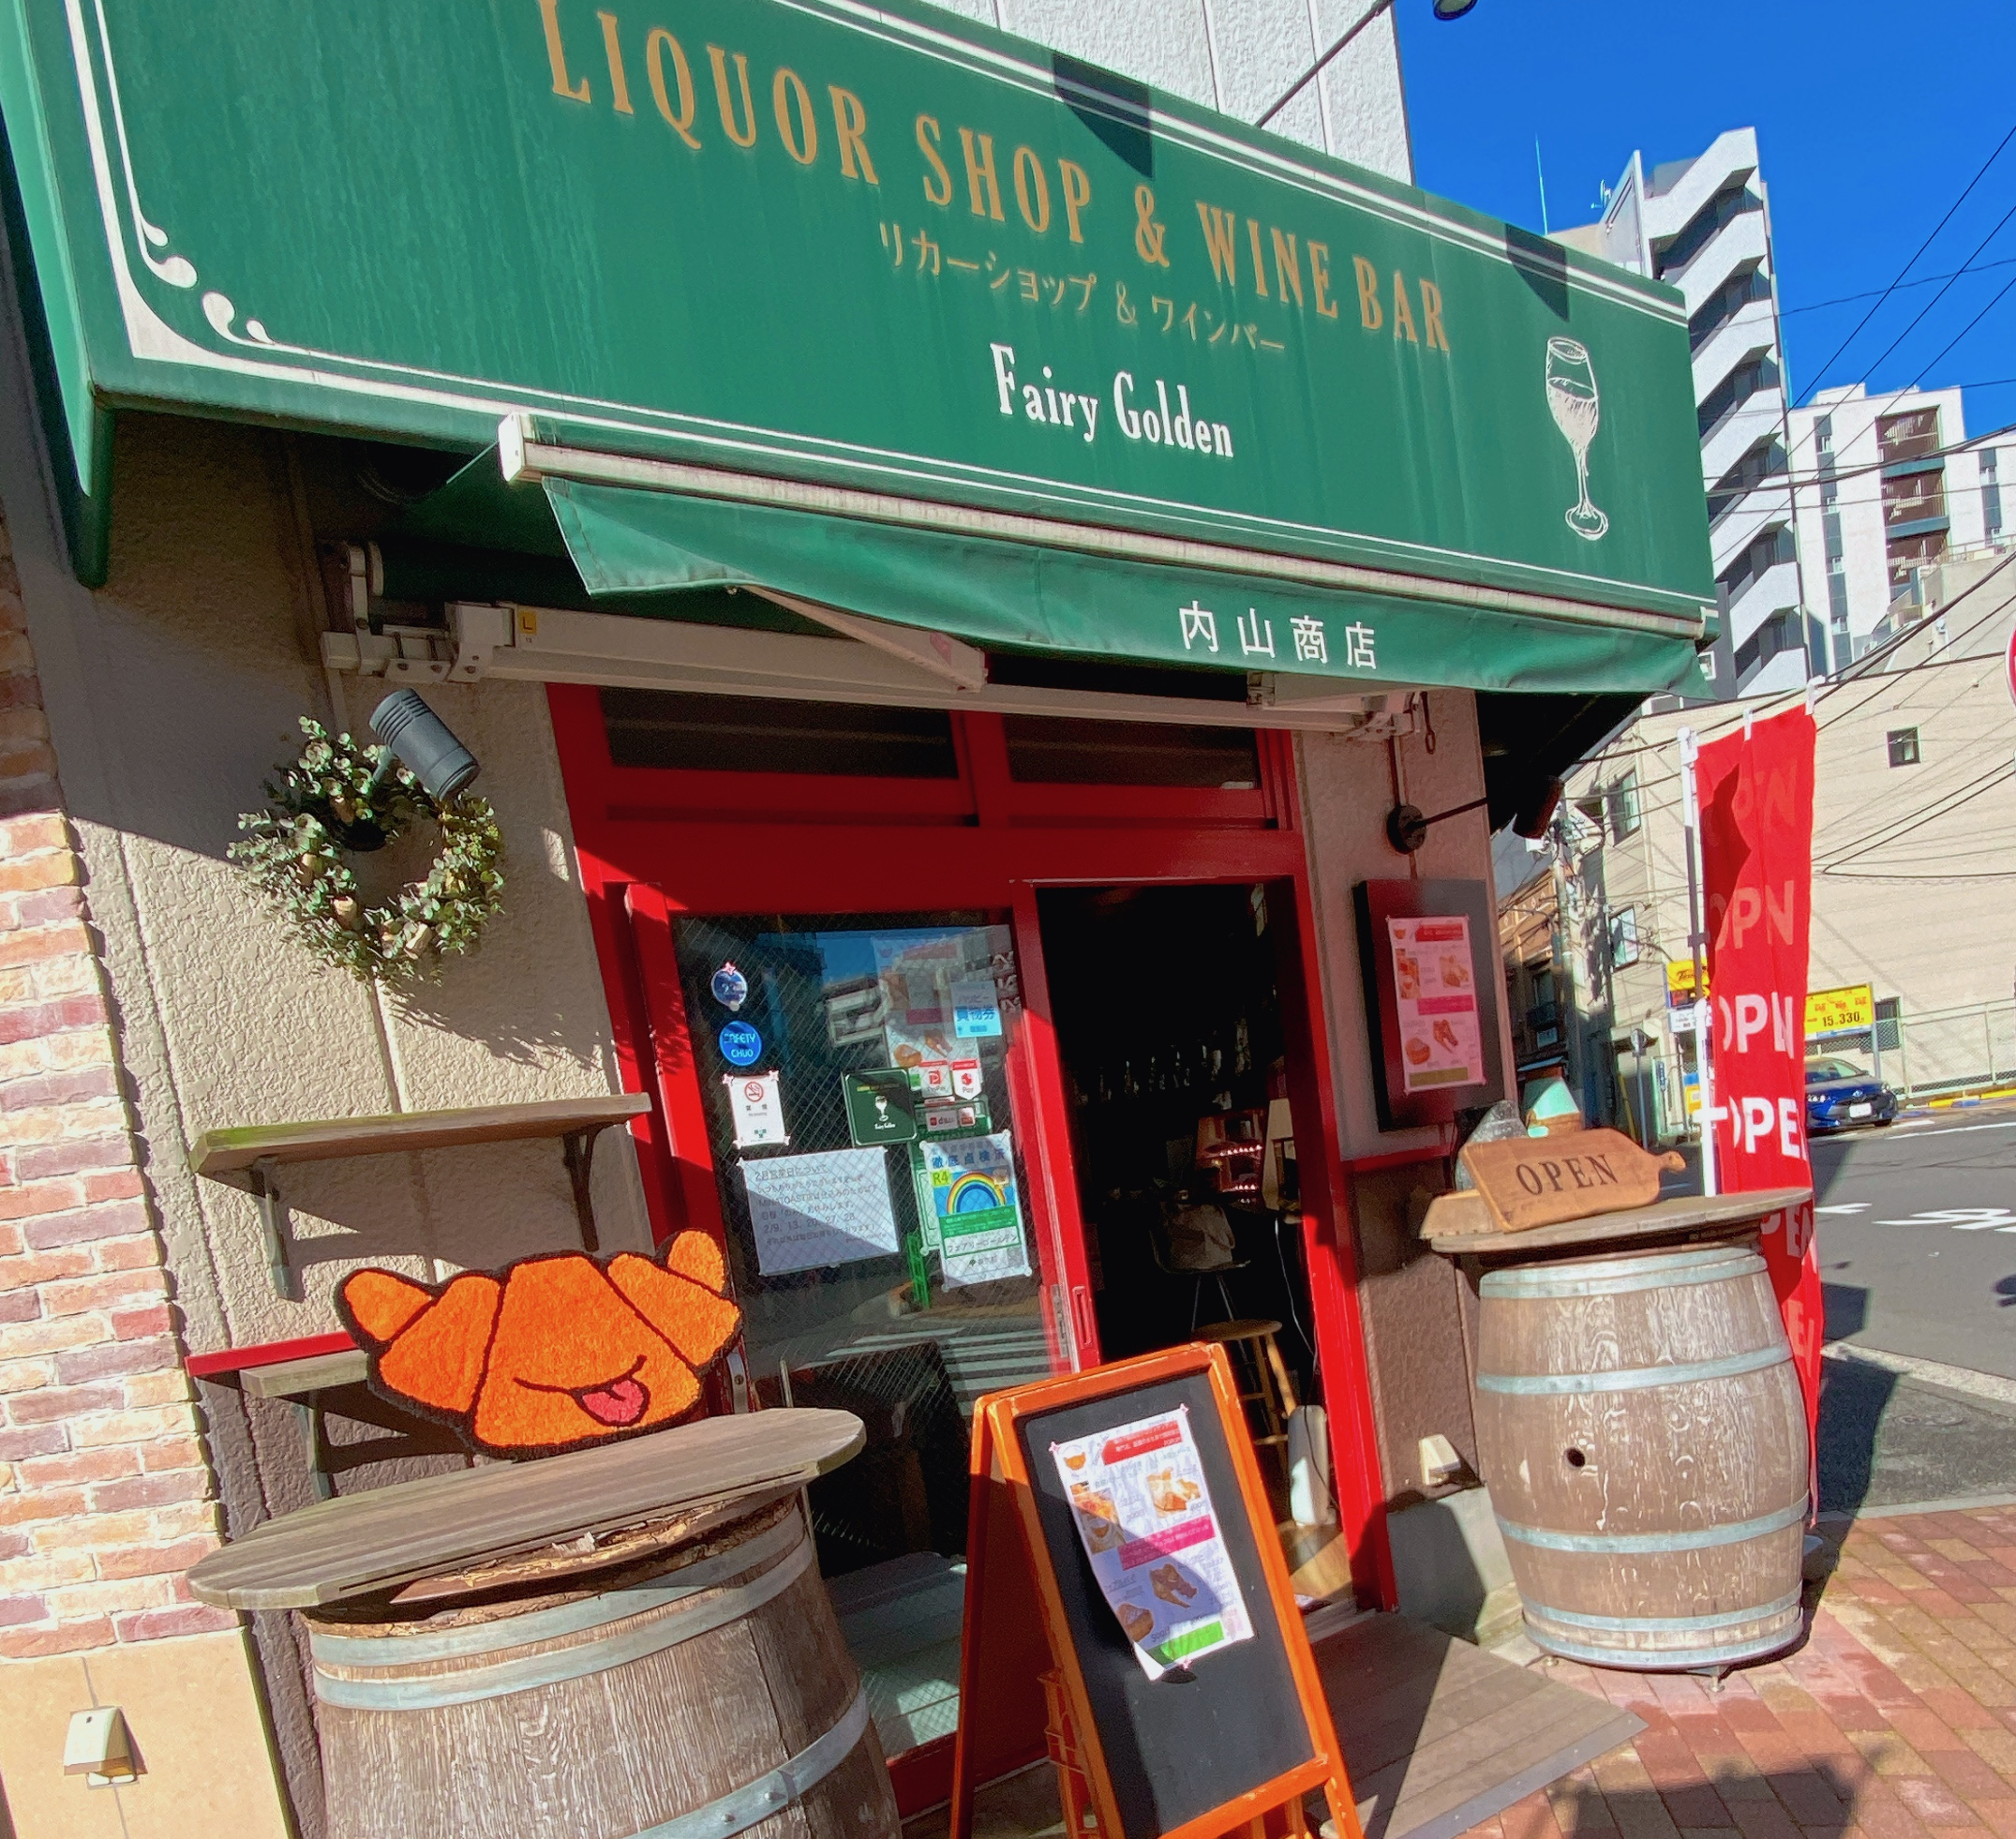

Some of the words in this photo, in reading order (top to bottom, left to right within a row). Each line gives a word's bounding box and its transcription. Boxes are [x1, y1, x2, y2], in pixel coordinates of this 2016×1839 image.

[538, 0, 879, 186] LIQUOR
[914, 113, 1091, 244] SHOP
[1134, 185, 1171, 269] &
[1196, 201, 1338, 321] WINE
[1352, 255, 1450, 351] BAR
[879, 222, 1098, 311] リカーショップ
[1115, 281, 1137, 323] &
[1151, 295, 1285, 351] ワインバー
[989, 342, 1098, 442] Fairy
[1113, 369, 1234, 458] Golden
[1177, 600, 1377, 670] 内山商店
[731, 1049, 754, 1058] CHUO
[932, 1172, 949, 1185] R4
[1516, 1153, 1619, 1196] OPEN
